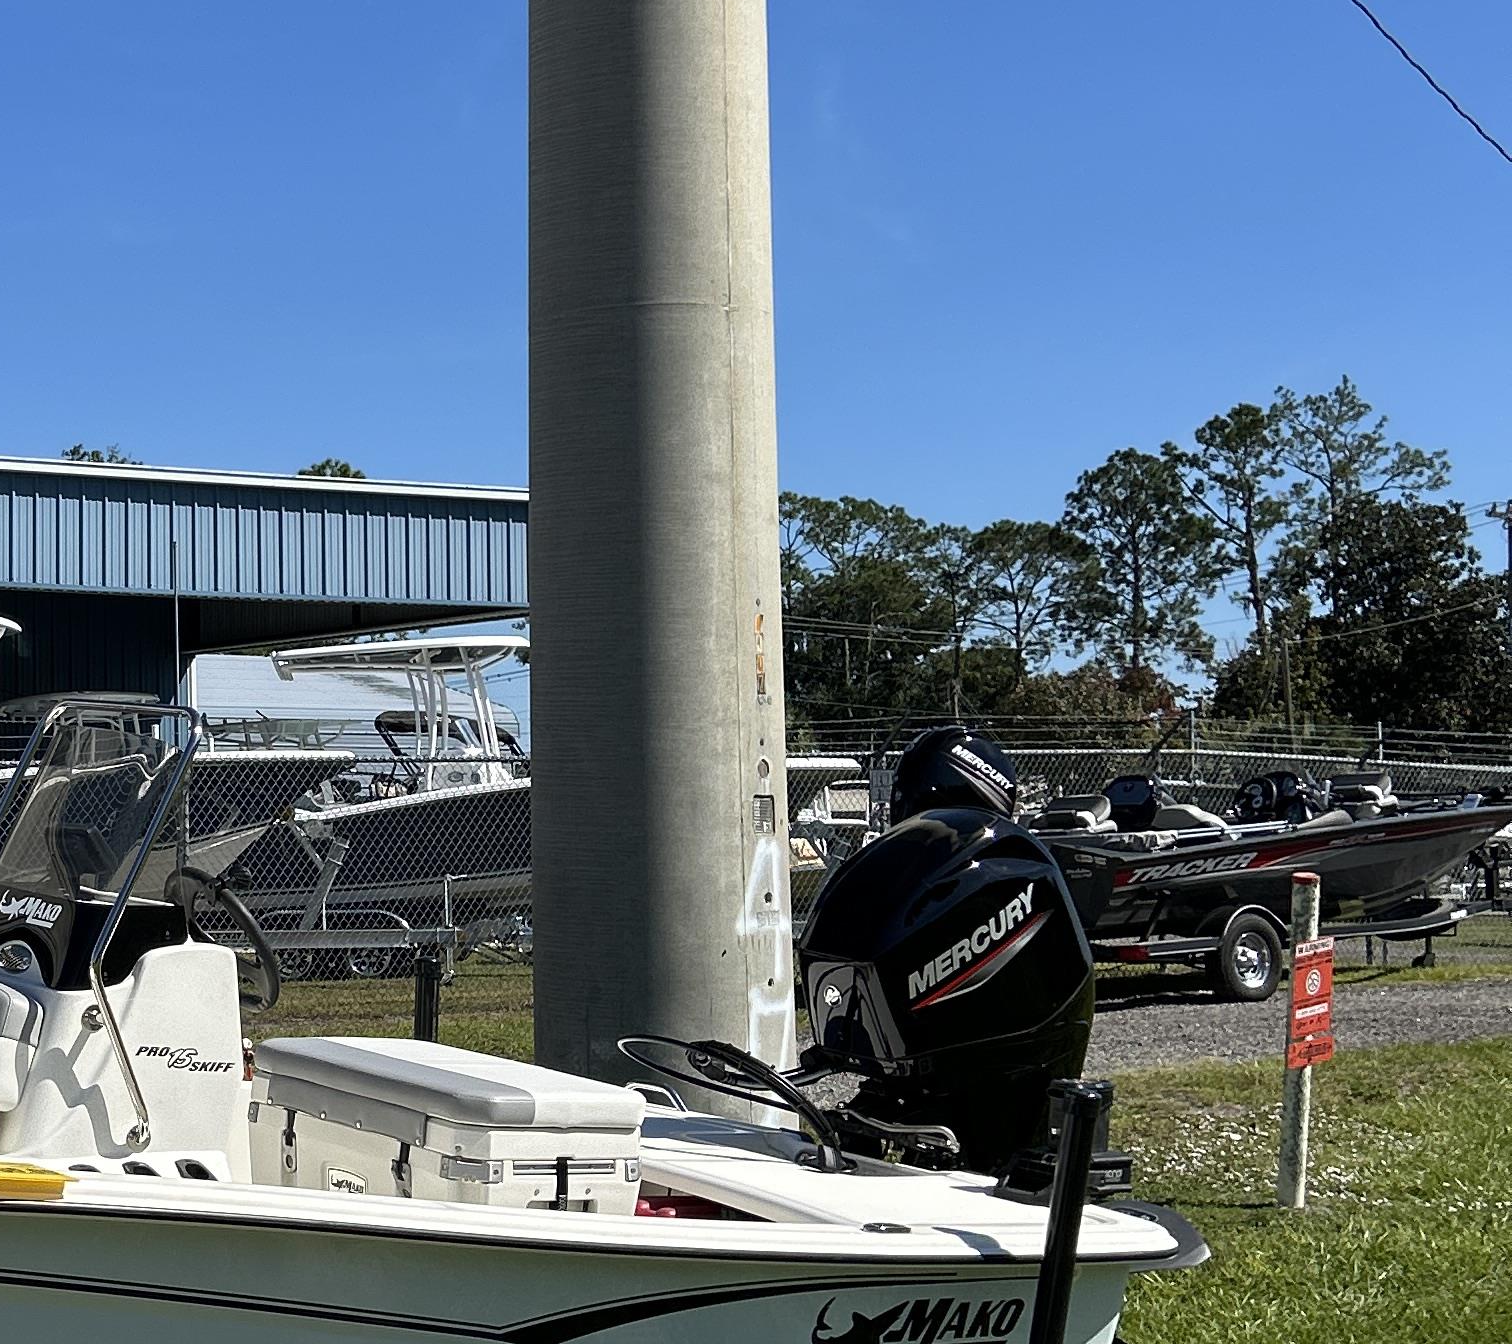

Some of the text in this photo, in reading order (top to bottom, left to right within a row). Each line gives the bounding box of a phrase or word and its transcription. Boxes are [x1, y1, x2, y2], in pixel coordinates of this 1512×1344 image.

[951, 744, 1014, 790] MERCURY
[1127, 852, 1258, 884] TRACKER
[18, 897, 63, 929] MAKO
[908, 882, 1034, 1000] MERCURY
[135, 1046, 236, 1073] PRO 15 SKIFF
